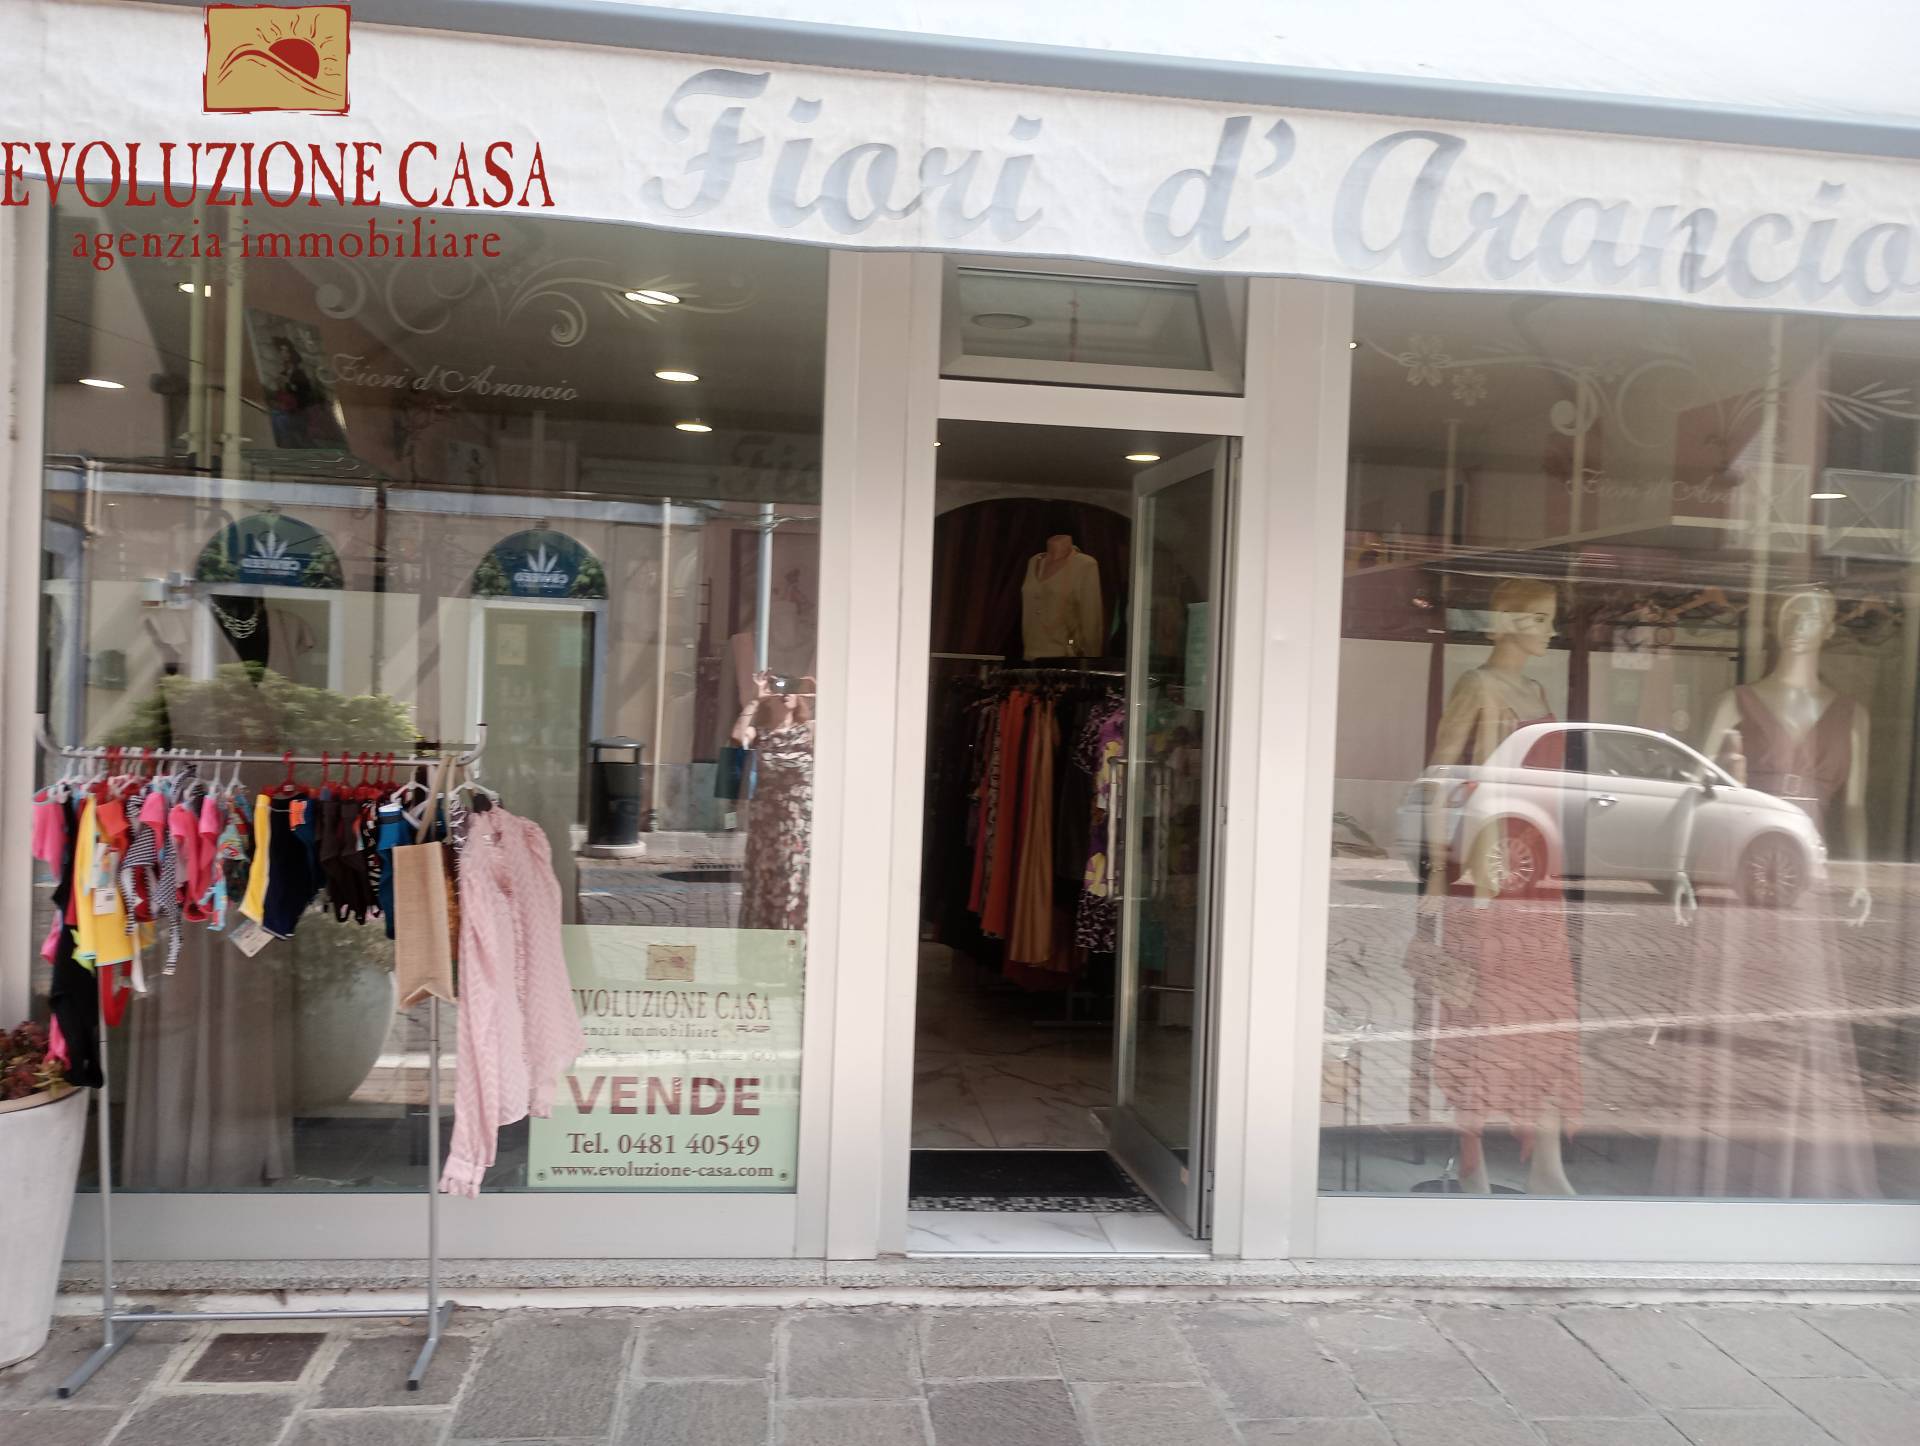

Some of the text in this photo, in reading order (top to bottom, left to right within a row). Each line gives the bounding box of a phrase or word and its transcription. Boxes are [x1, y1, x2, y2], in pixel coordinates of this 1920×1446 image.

[641, 68, 1044, 243] Fiori
[1332, 130, 1920, 308] Arancio
[316, 353, 408, 389] Fiori
[571, 989, 772, 1021] VOLUZIONE CASA
[625, 1023, 720, 1038] immobiliare
[566, 1075, 761, 1116] VENDE
[567, 1132, 760, 1156] Tel. 0481 40549
[551, 1162, 774, 1178] www.evoluzione-casa.com
